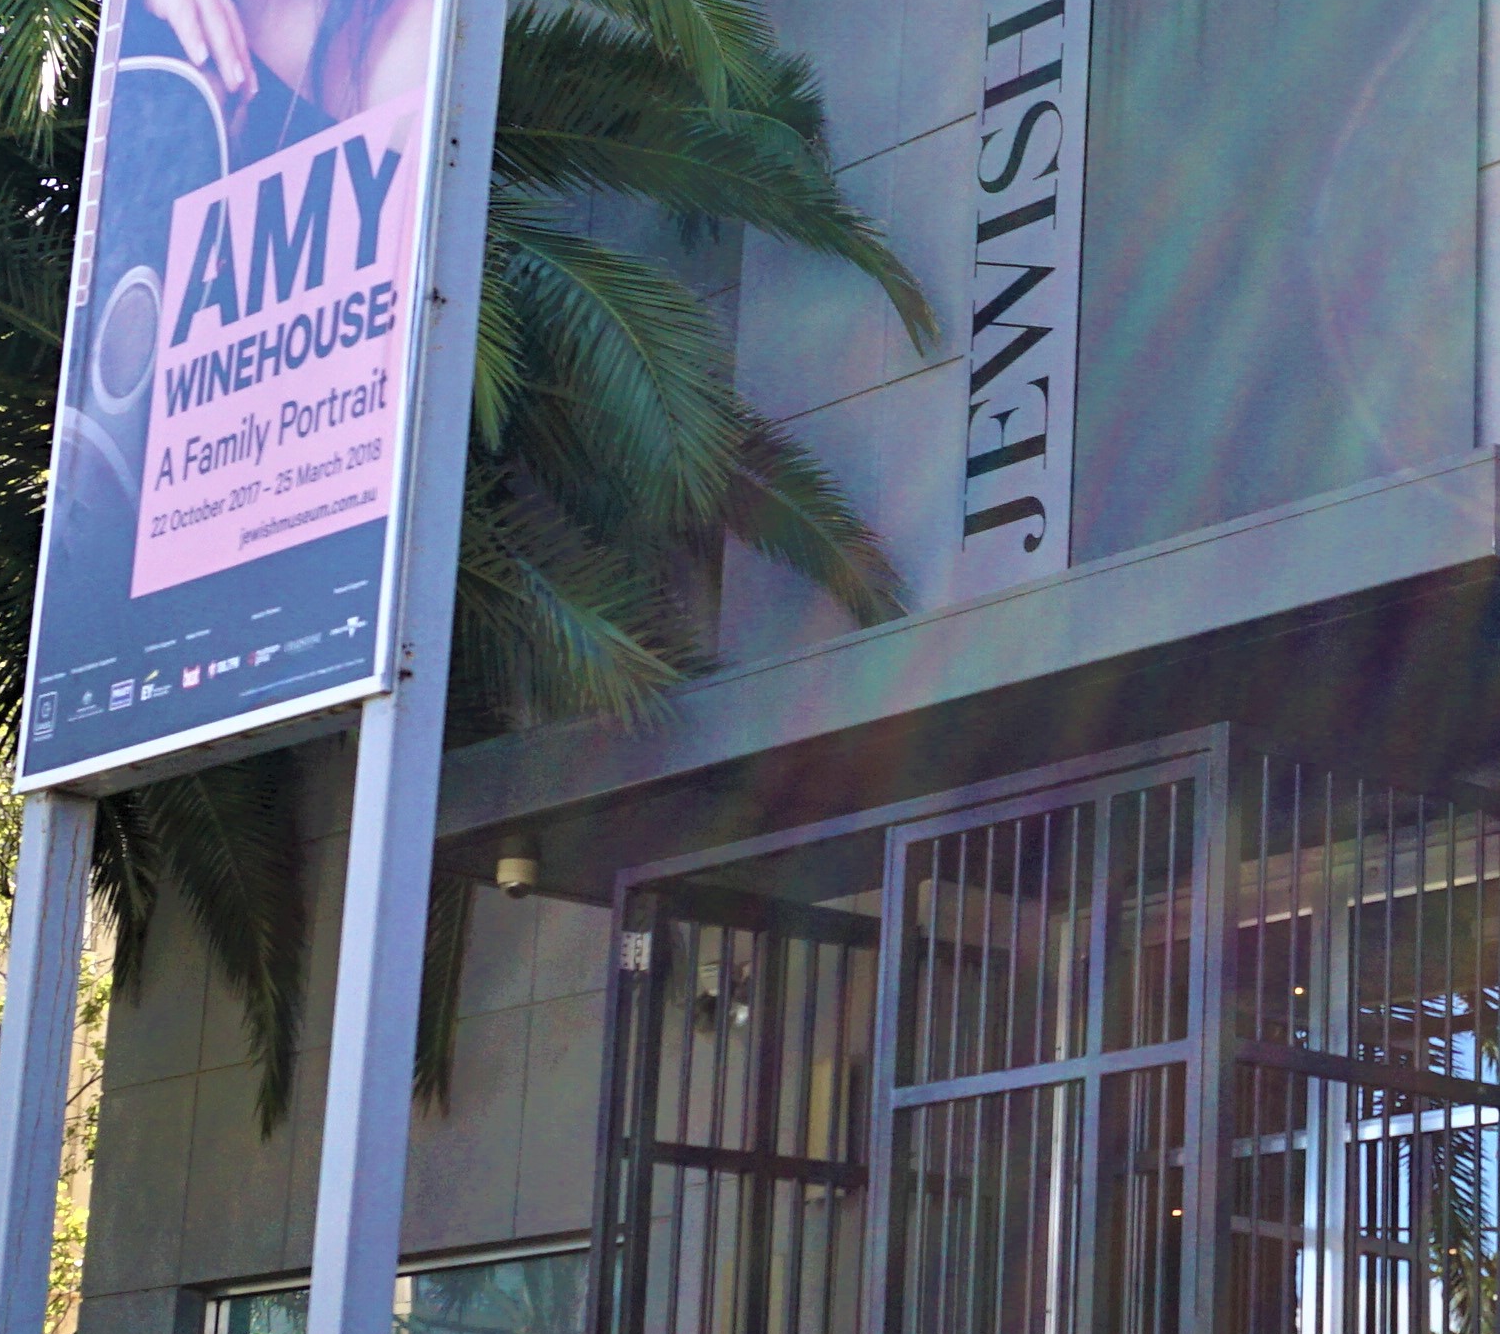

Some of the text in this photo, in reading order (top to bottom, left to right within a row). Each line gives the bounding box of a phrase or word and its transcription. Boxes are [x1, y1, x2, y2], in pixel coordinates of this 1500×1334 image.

[170, 134, 402, 349] AMY
[165, 280, 398, 418] WINEHOUSE:
[150, 515, 169, 539] 22
[169, 496, 226, 532] October
[227, 480, 263, 513] 2017
[273, 468, 294, 496] 25
[295, 450, 344, 488] March
[345, 436, 383, 471] 2018
[154, 367, 389, 492] A Family Portrait
[237, 487, 379, 552] jewishmuseum.com.au
